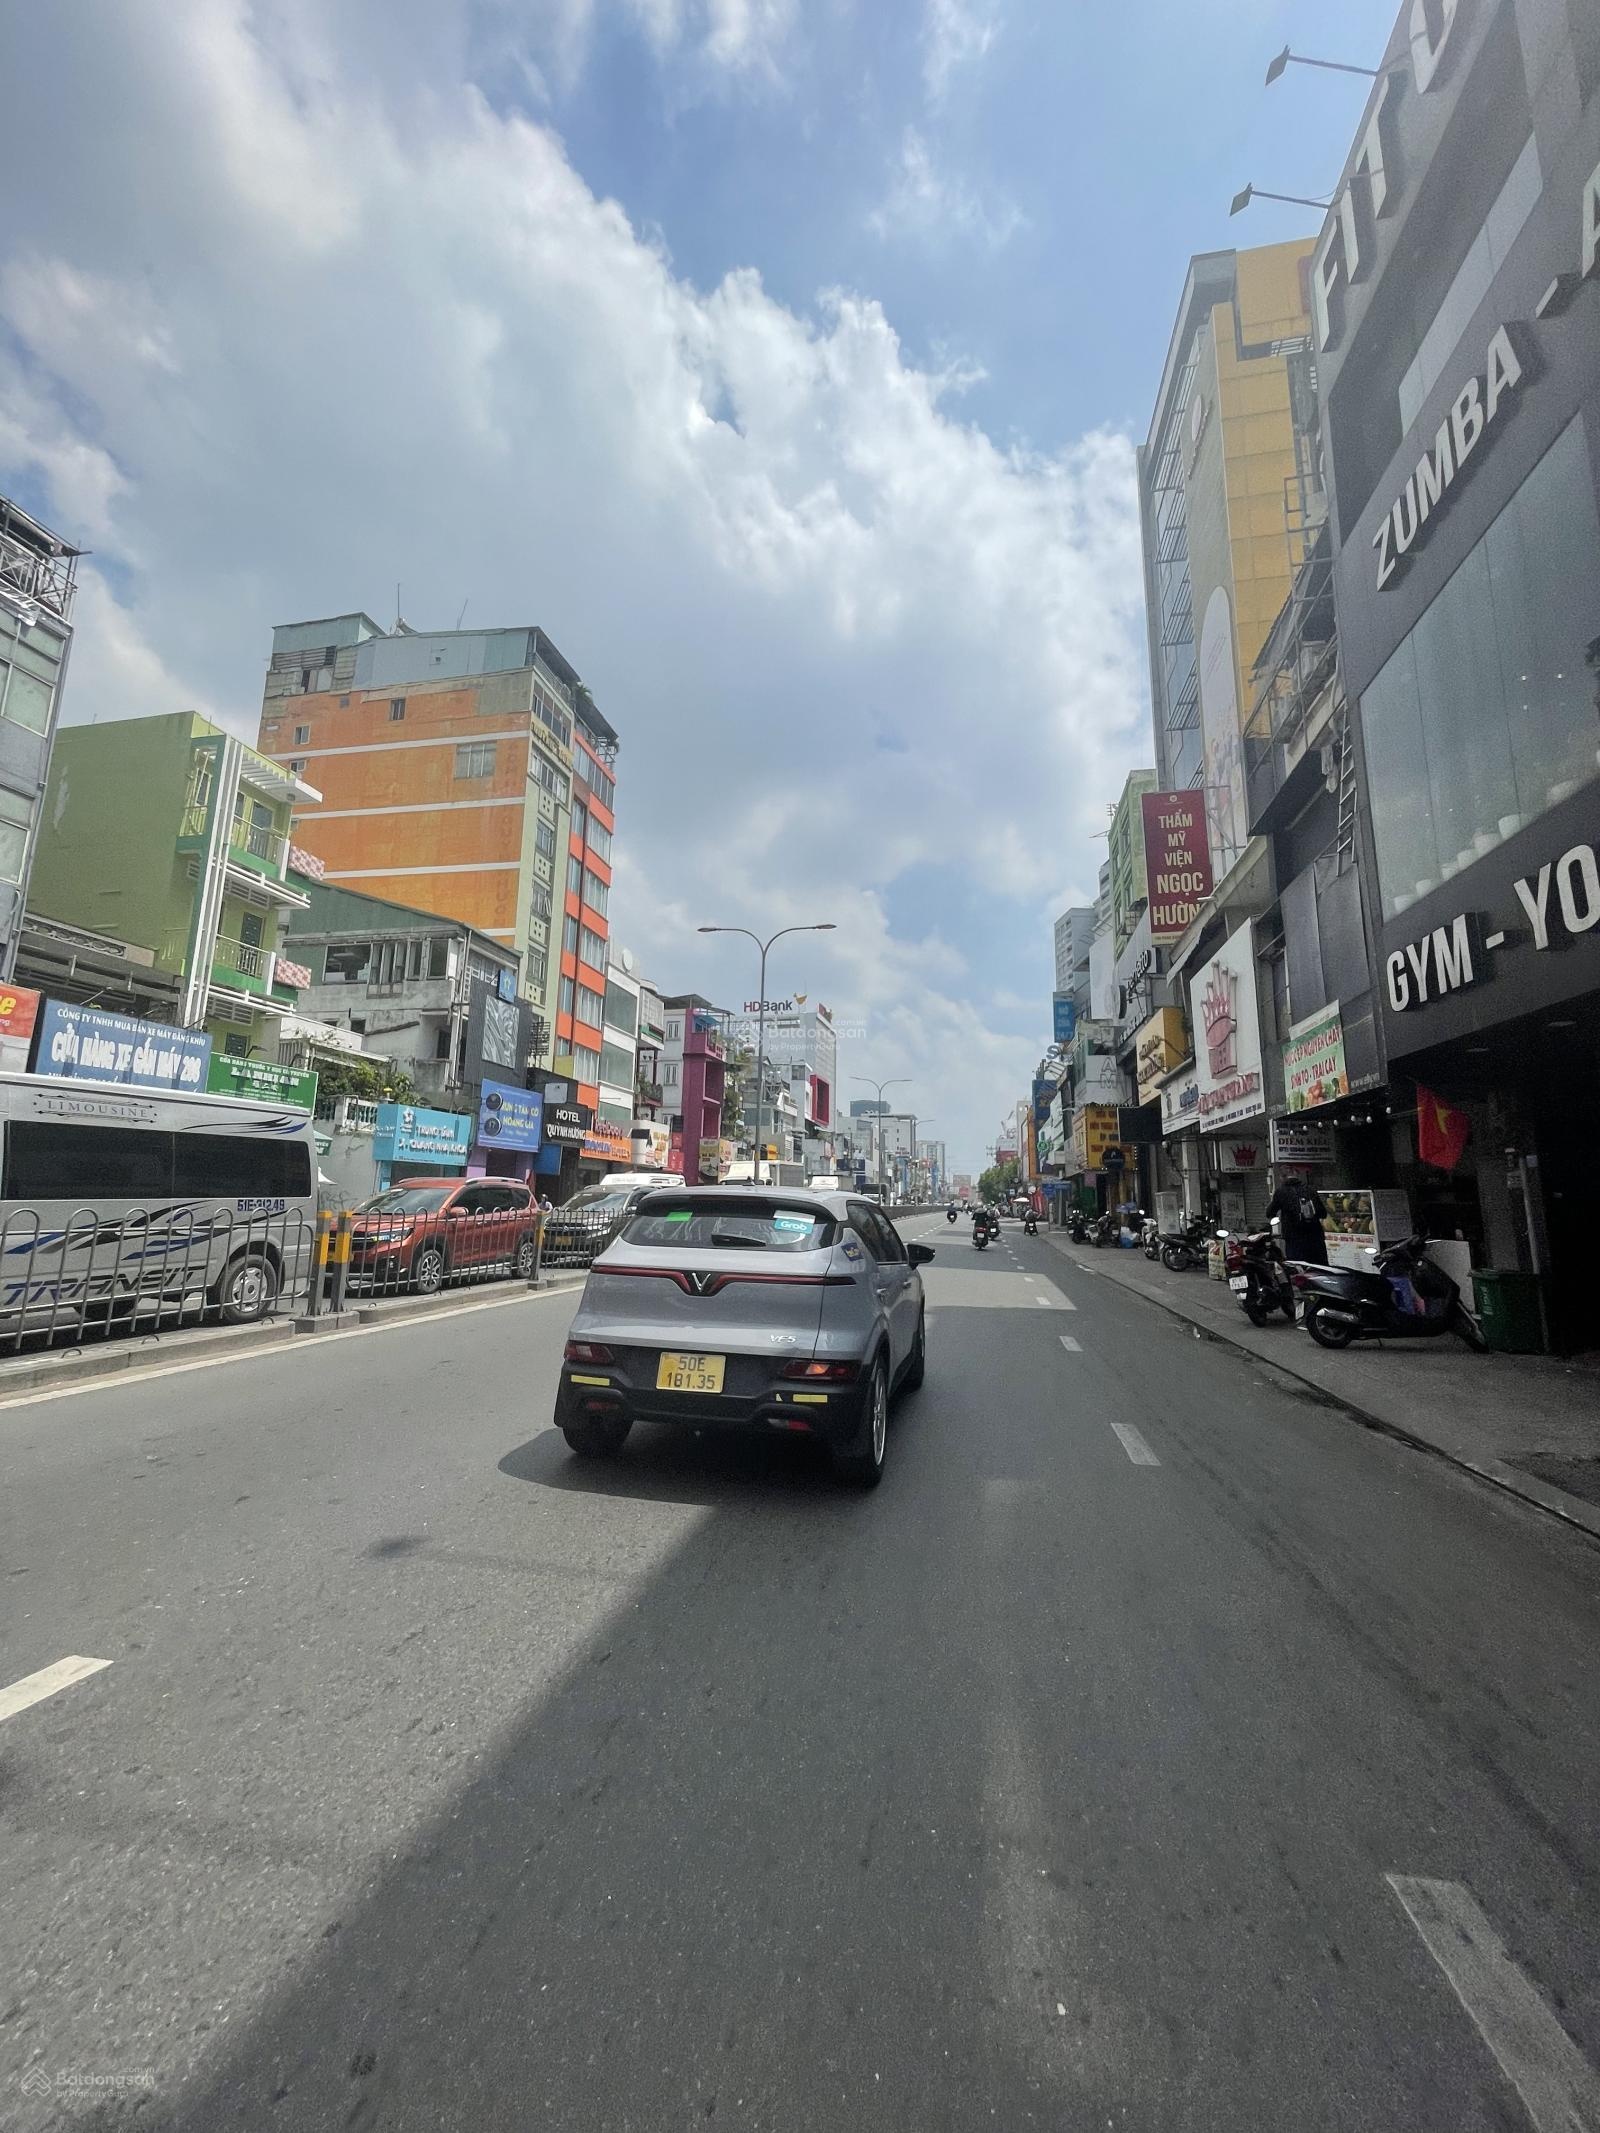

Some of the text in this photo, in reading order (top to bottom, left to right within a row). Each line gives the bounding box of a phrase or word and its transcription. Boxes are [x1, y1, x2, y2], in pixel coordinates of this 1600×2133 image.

[1372, 324, 1522, 593] ZUMBA
[1158, 808, 1193, 829] THẨM
[1167, 830, 1186, 847] MỸ
[1165, 850, 1193, 868] VIỆN
[1157, 871, 1204, 896] NGỌC
[1386, 913, 1474, 1012] GYM
[743, 999, 793, 1013] HDBank
[57, 1007, 80, 1021] CÔNG
[81, 1013, 91, 1023] TY
[92, 1015, 113, 1027] TNHH
[114, 1020, 131, 1031] MUA
[147, 1027, 157, 1036] XE
[157, 1028, 172, 1039] MÁY
[113, 1042, 134, 1071] XE
[47, 1100, 148, 1118] LIMOUSINE
[556, 1108, 581, 1123] HOTEL
[780, 1220, 808, 1231] Grab
[4, 1265, 208, 1306] TRANSIT
[678, 1356, 706, 1372] 50E
[666, 1371, 717, 1390] 181.35
